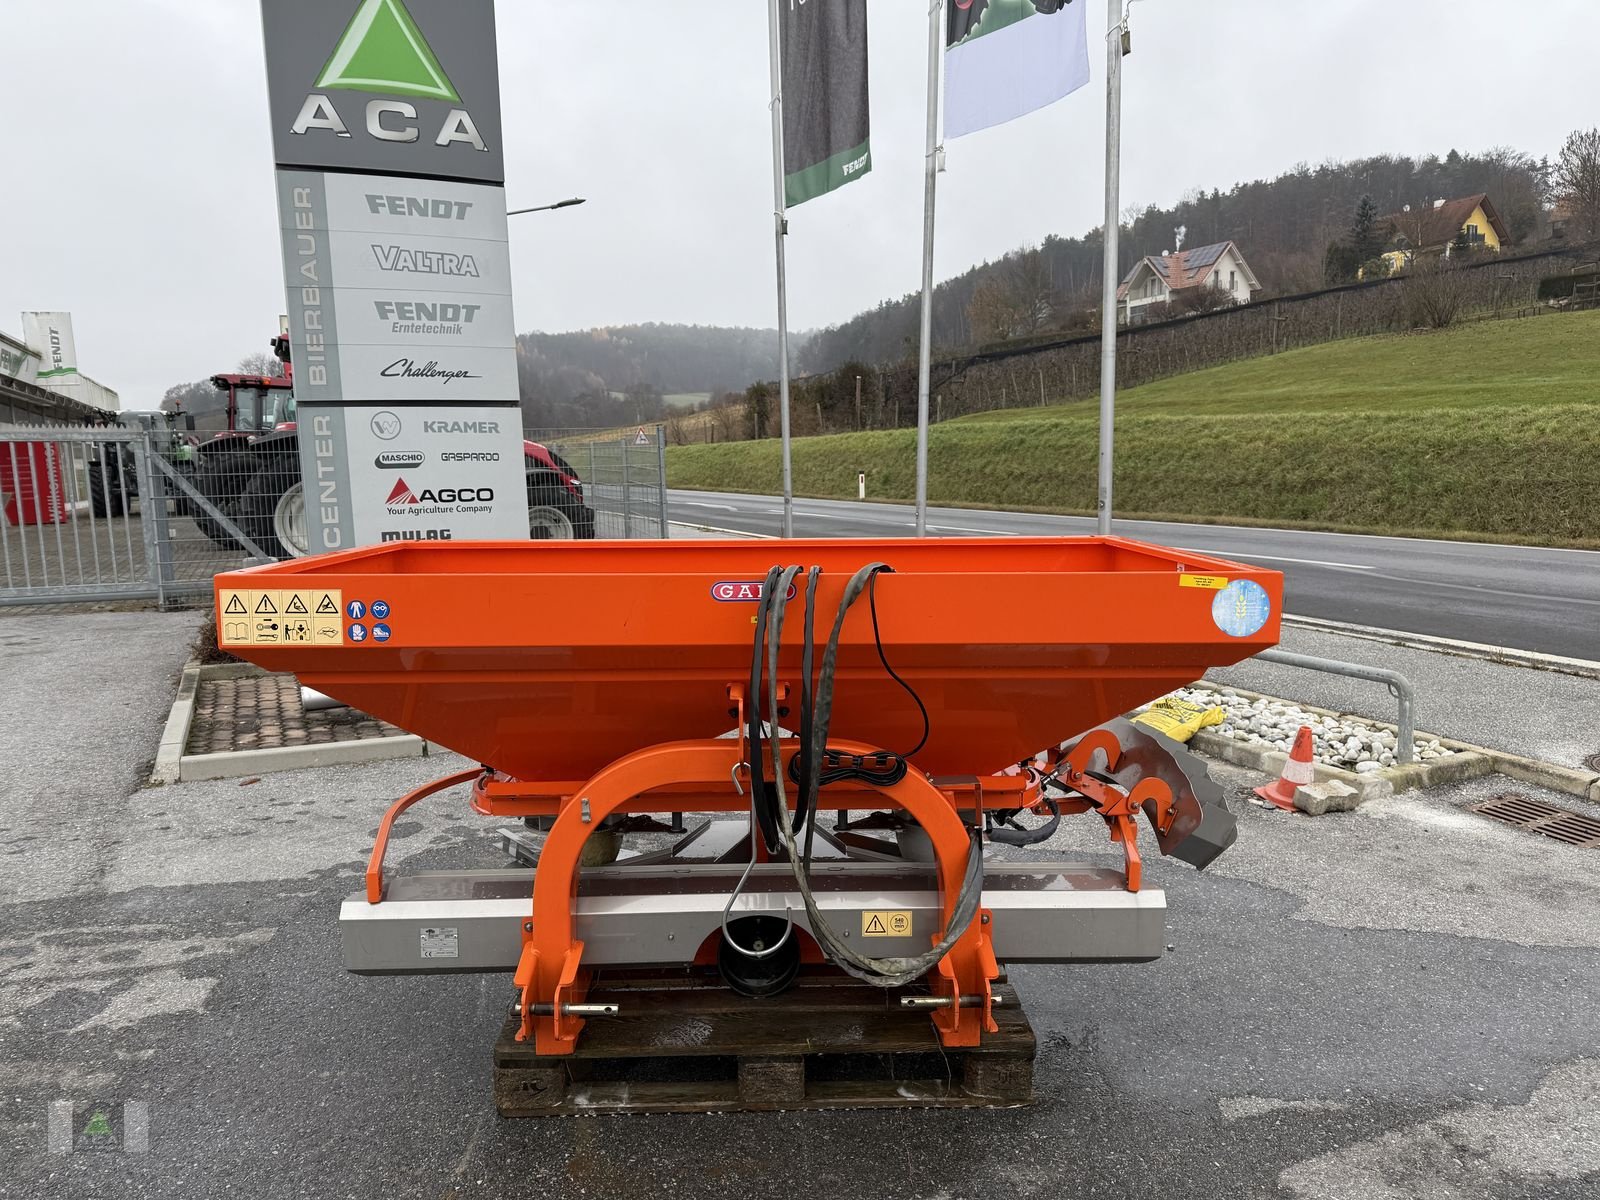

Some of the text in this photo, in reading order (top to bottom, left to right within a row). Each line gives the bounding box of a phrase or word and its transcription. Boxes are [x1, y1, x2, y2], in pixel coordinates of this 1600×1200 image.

[289, 93, 490, 153] ACA
[842, 151, 868, 176] FENDT
[365, 194, 473, 221] FENDT
[371, 244, 480, 278] VALTRA
[374, 300, 481, 323] FENDT
[391, 322, 463, 335] Erntetechnik
[48, 326, 63, 369] FENDT
[293, 186, 342, 548] CENTER BIERBAUER
[380, 358, 483, 385] Challenger
[423, 420, 501, 434] KRAMER
[381, 454, 423, 462] MASCHIO
[441, 452, 500, 462] GASPARDO
[419, 488, 494, 504] AGCO
[386, 503, 493, 516] Your Agriculture Company
